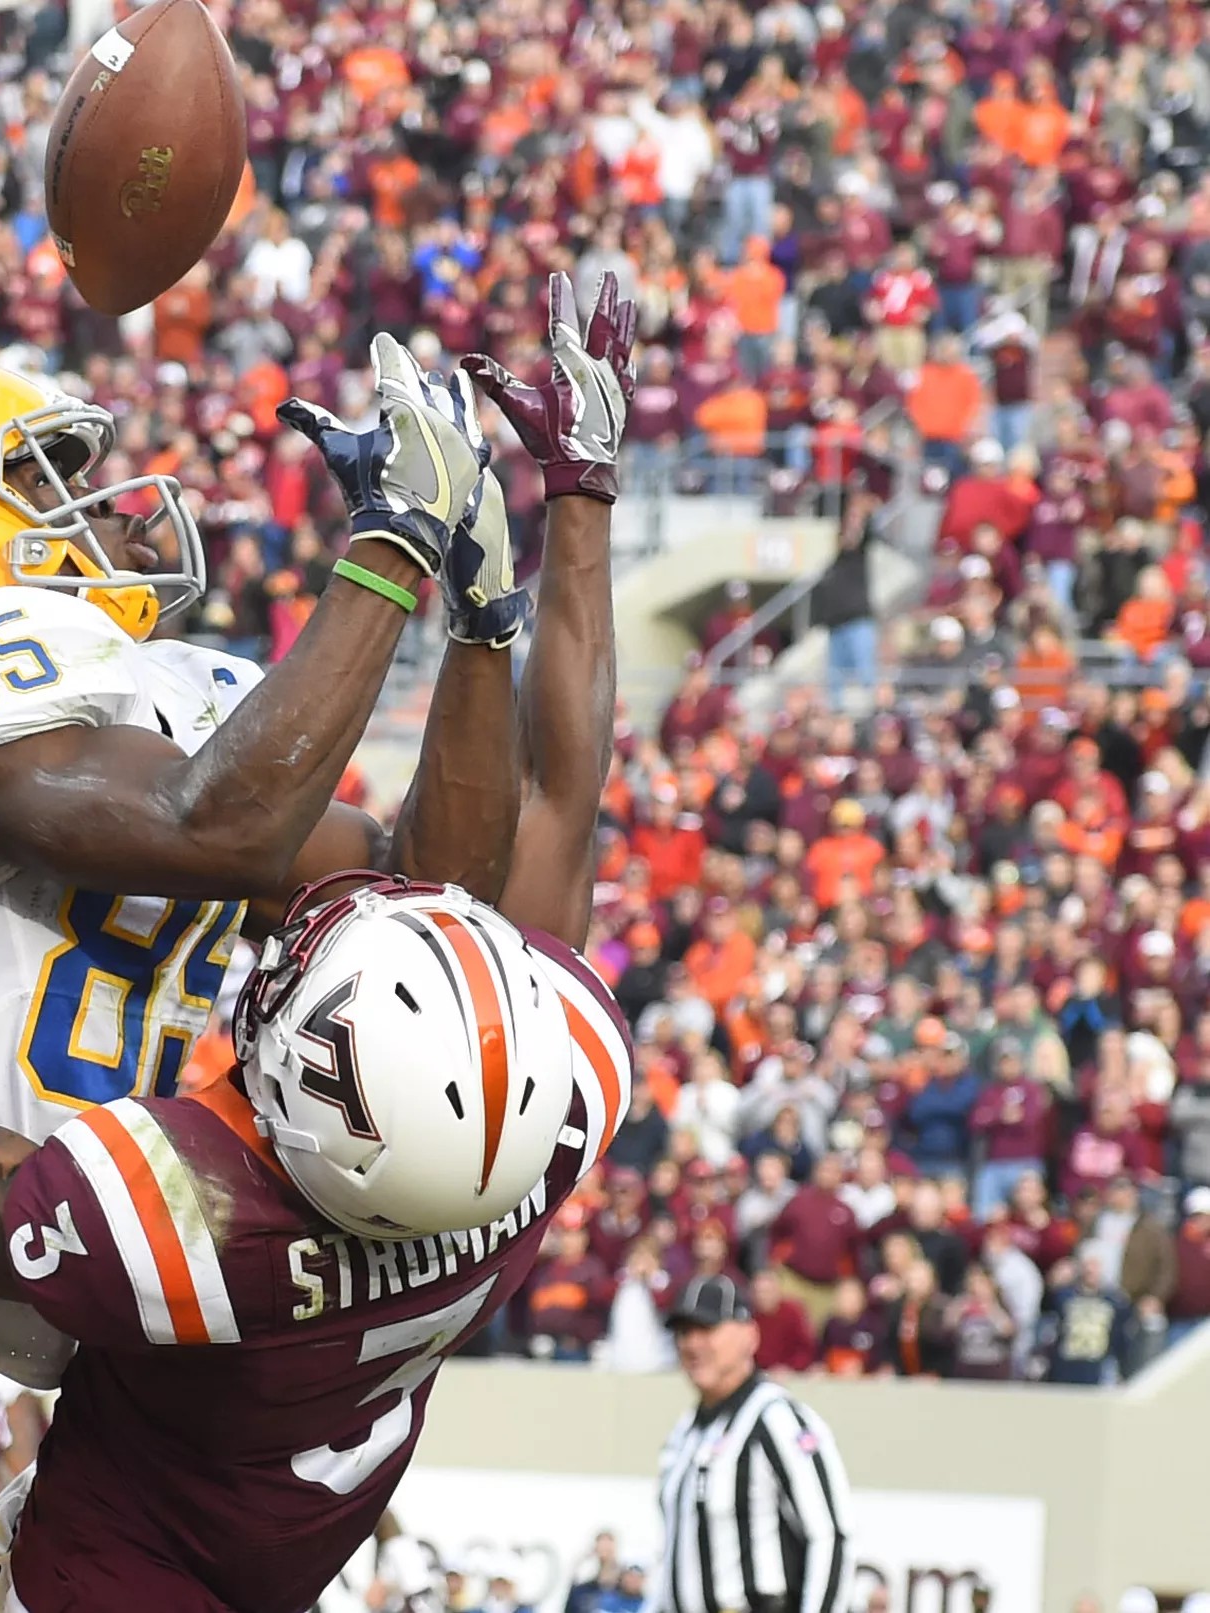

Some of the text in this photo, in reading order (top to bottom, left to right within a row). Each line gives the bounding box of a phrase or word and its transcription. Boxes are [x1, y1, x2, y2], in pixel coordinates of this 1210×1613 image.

[119, 146, 174, 218] Pitt
[9, 1200, 89, 1281] 3
[287, 1175, 547, 1322] STROMAN
[290, 1271, 500, 1496] 3
